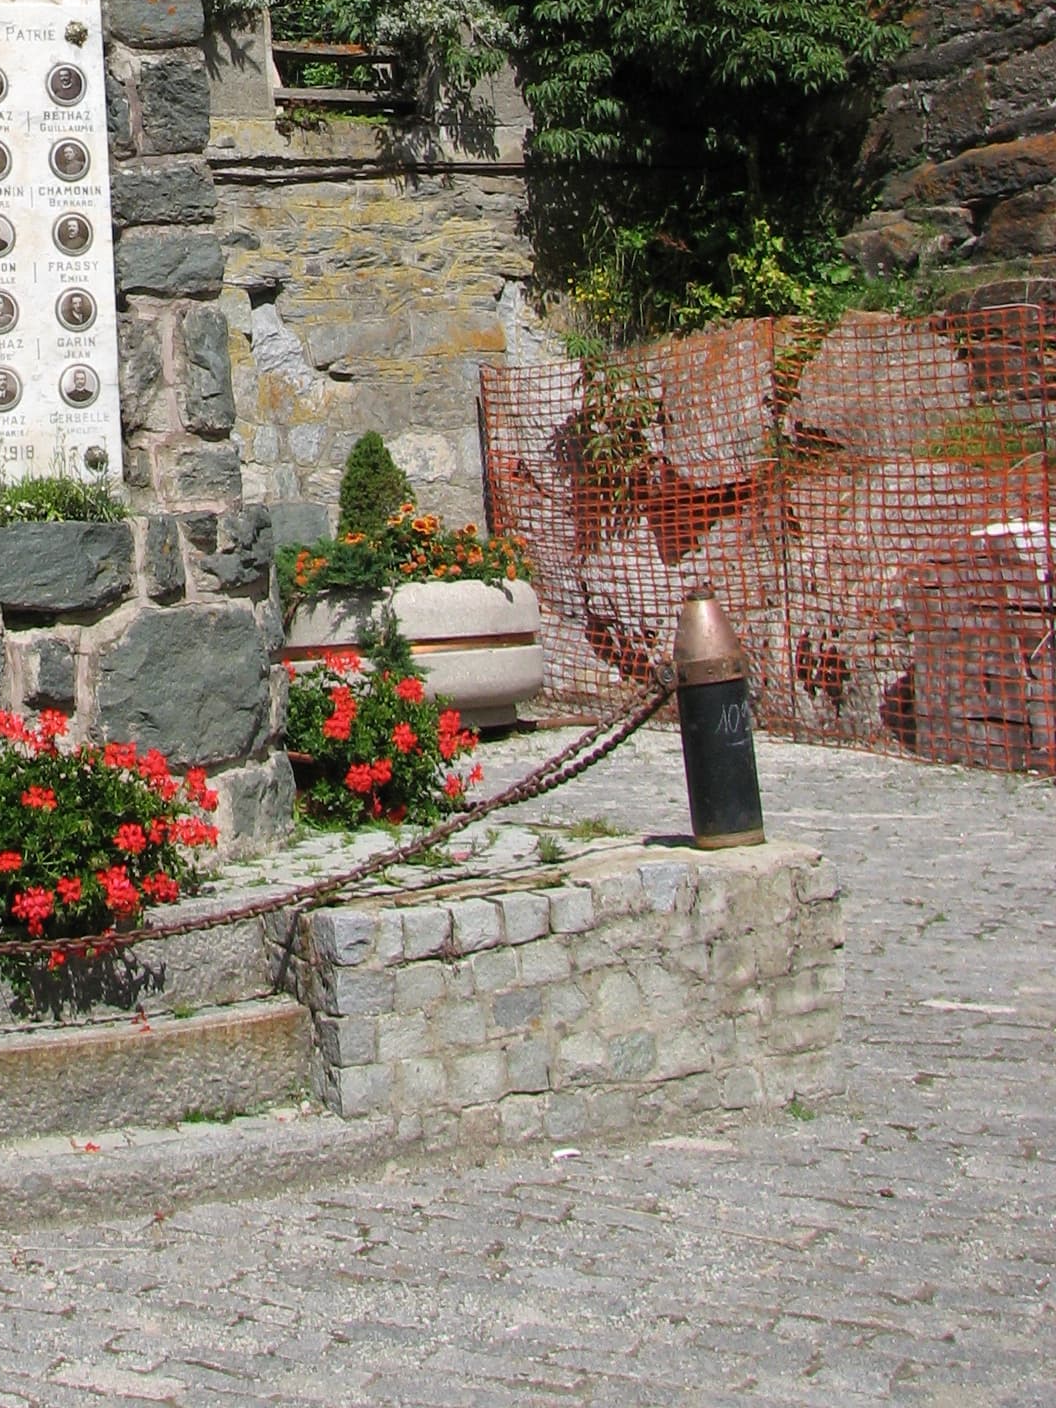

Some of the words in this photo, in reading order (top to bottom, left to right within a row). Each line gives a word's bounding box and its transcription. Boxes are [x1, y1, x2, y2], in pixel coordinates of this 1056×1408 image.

[38, 186, 102, 196] CHAMONIN
[48, 261, 99, 272] FRASSY
[57, 337, 96, 348] GARIN
